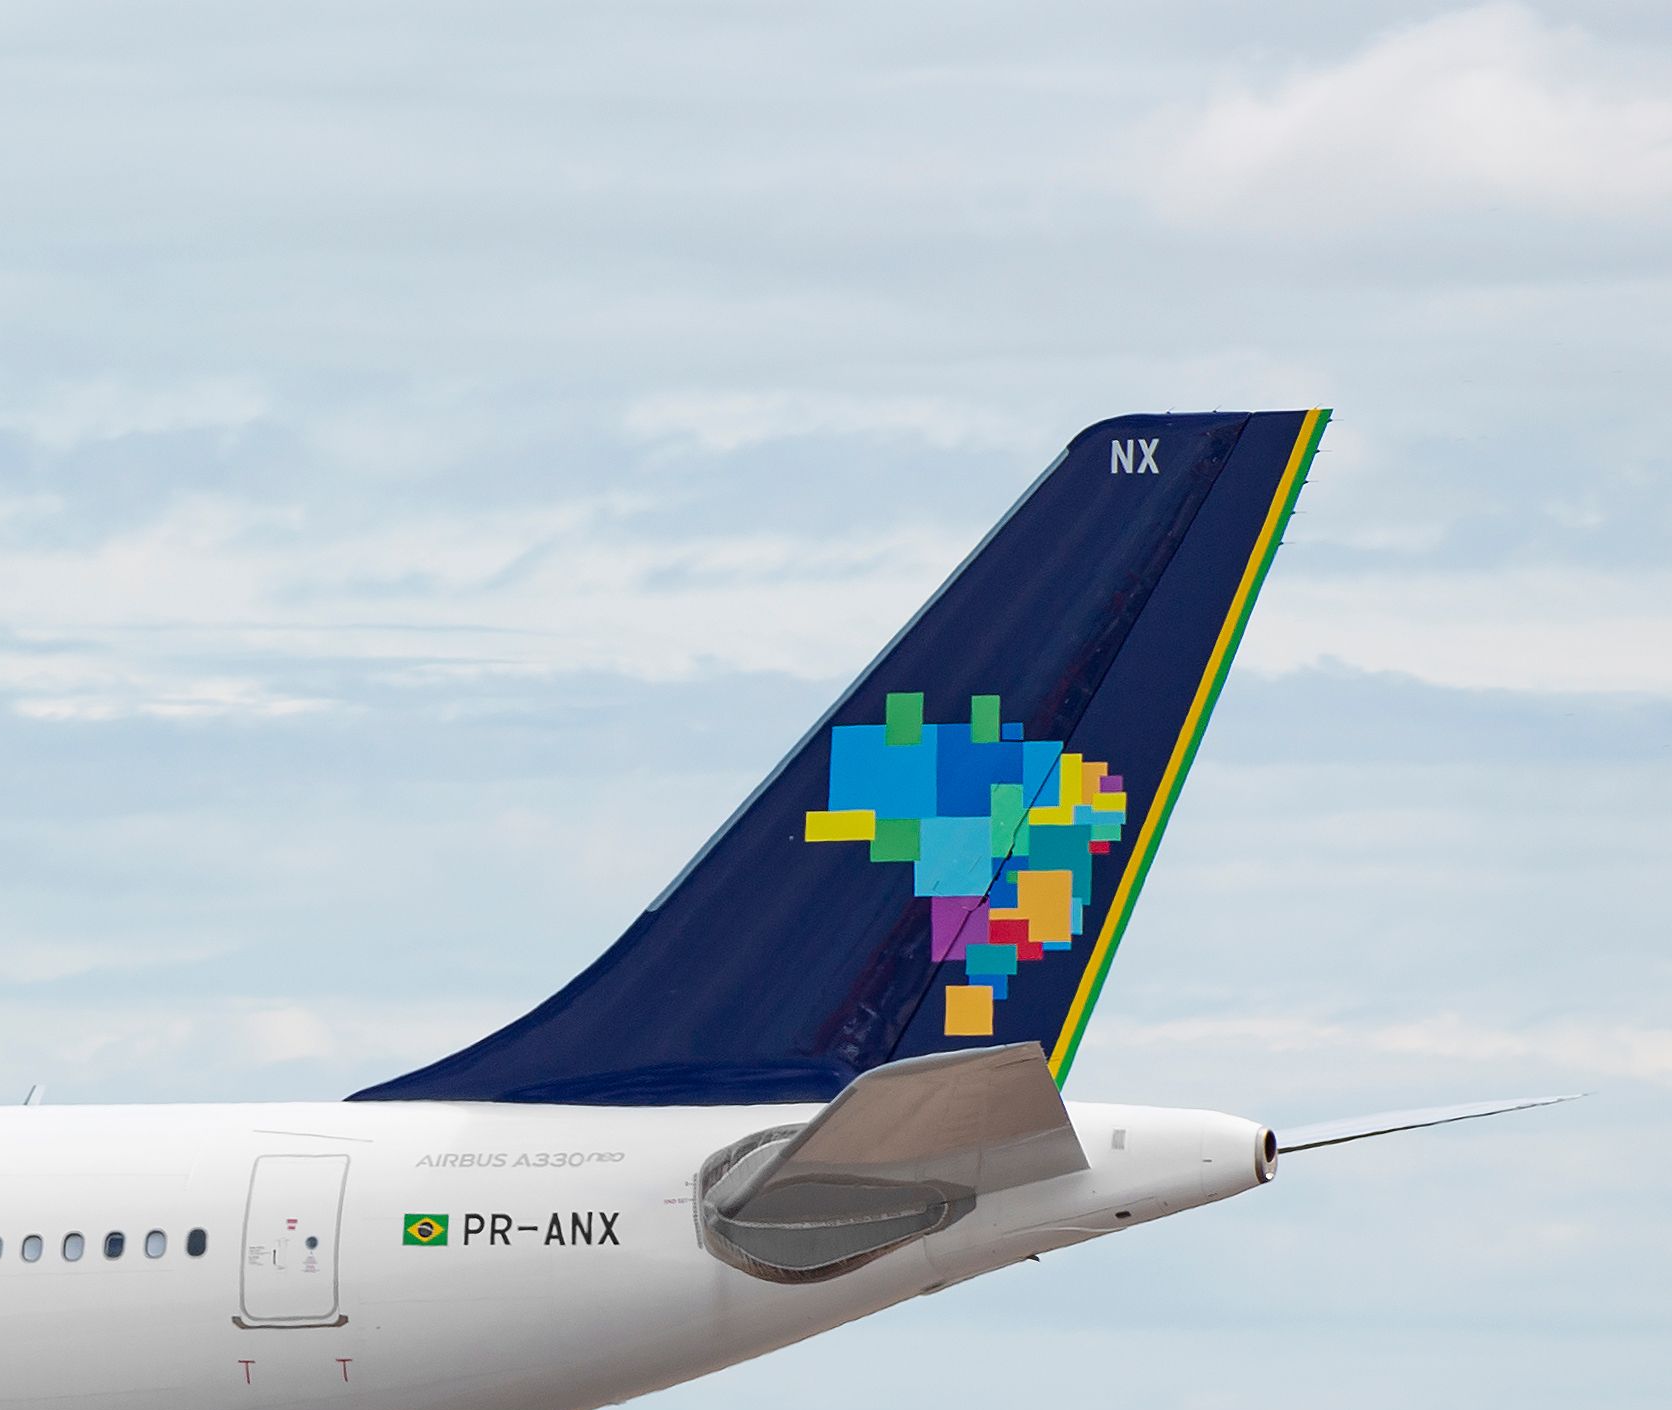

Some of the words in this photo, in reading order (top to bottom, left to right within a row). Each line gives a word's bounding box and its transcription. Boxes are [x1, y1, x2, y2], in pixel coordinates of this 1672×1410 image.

[1111, 438, 1160, 474] NX
[415, 1153, 508, 1168] AIRBUS
[463, 1212, 620, 1246] PR-ANX
